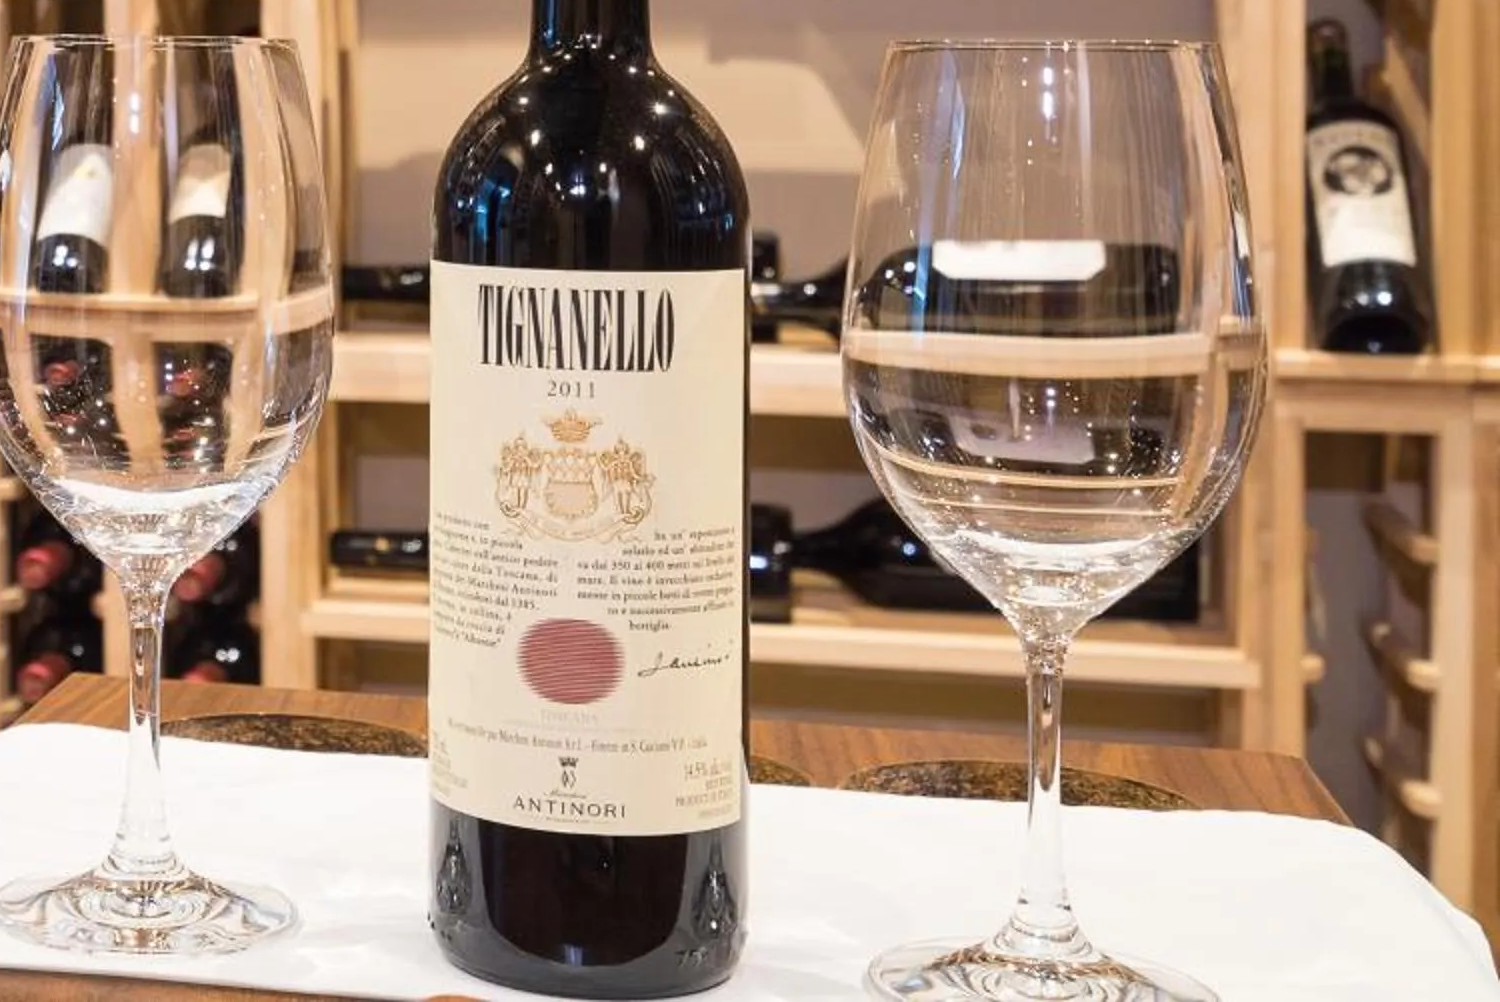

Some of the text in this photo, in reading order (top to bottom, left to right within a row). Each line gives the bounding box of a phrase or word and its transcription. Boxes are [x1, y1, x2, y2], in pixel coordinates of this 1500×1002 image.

[478, 284, 675, 372] TIGNANELLO
[547, 381, 596, 398] 2011
[513, 794, 626, 819] ANTINORI
